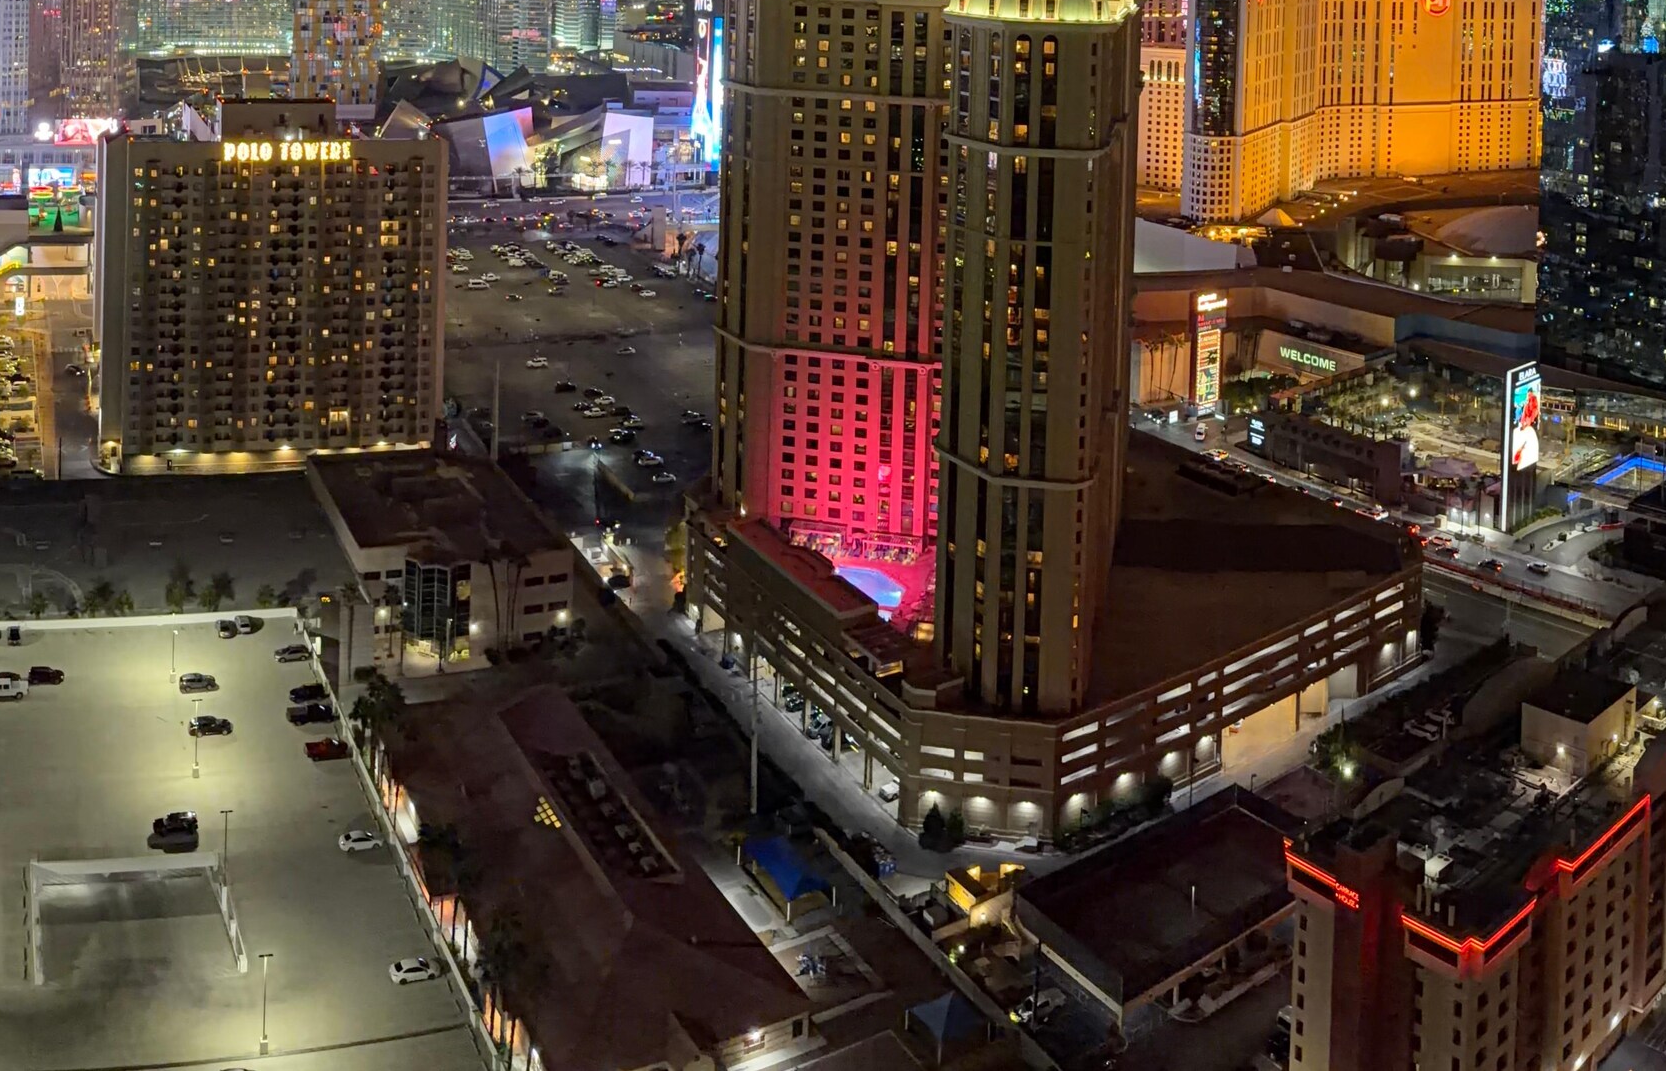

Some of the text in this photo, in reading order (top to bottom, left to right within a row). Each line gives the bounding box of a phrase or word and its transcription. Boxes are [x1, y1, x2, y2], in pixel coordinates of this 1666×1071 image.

[222, 140, 352, 162] POLO TOWERS
[1279, 346, 1337, 372] WELCOME
